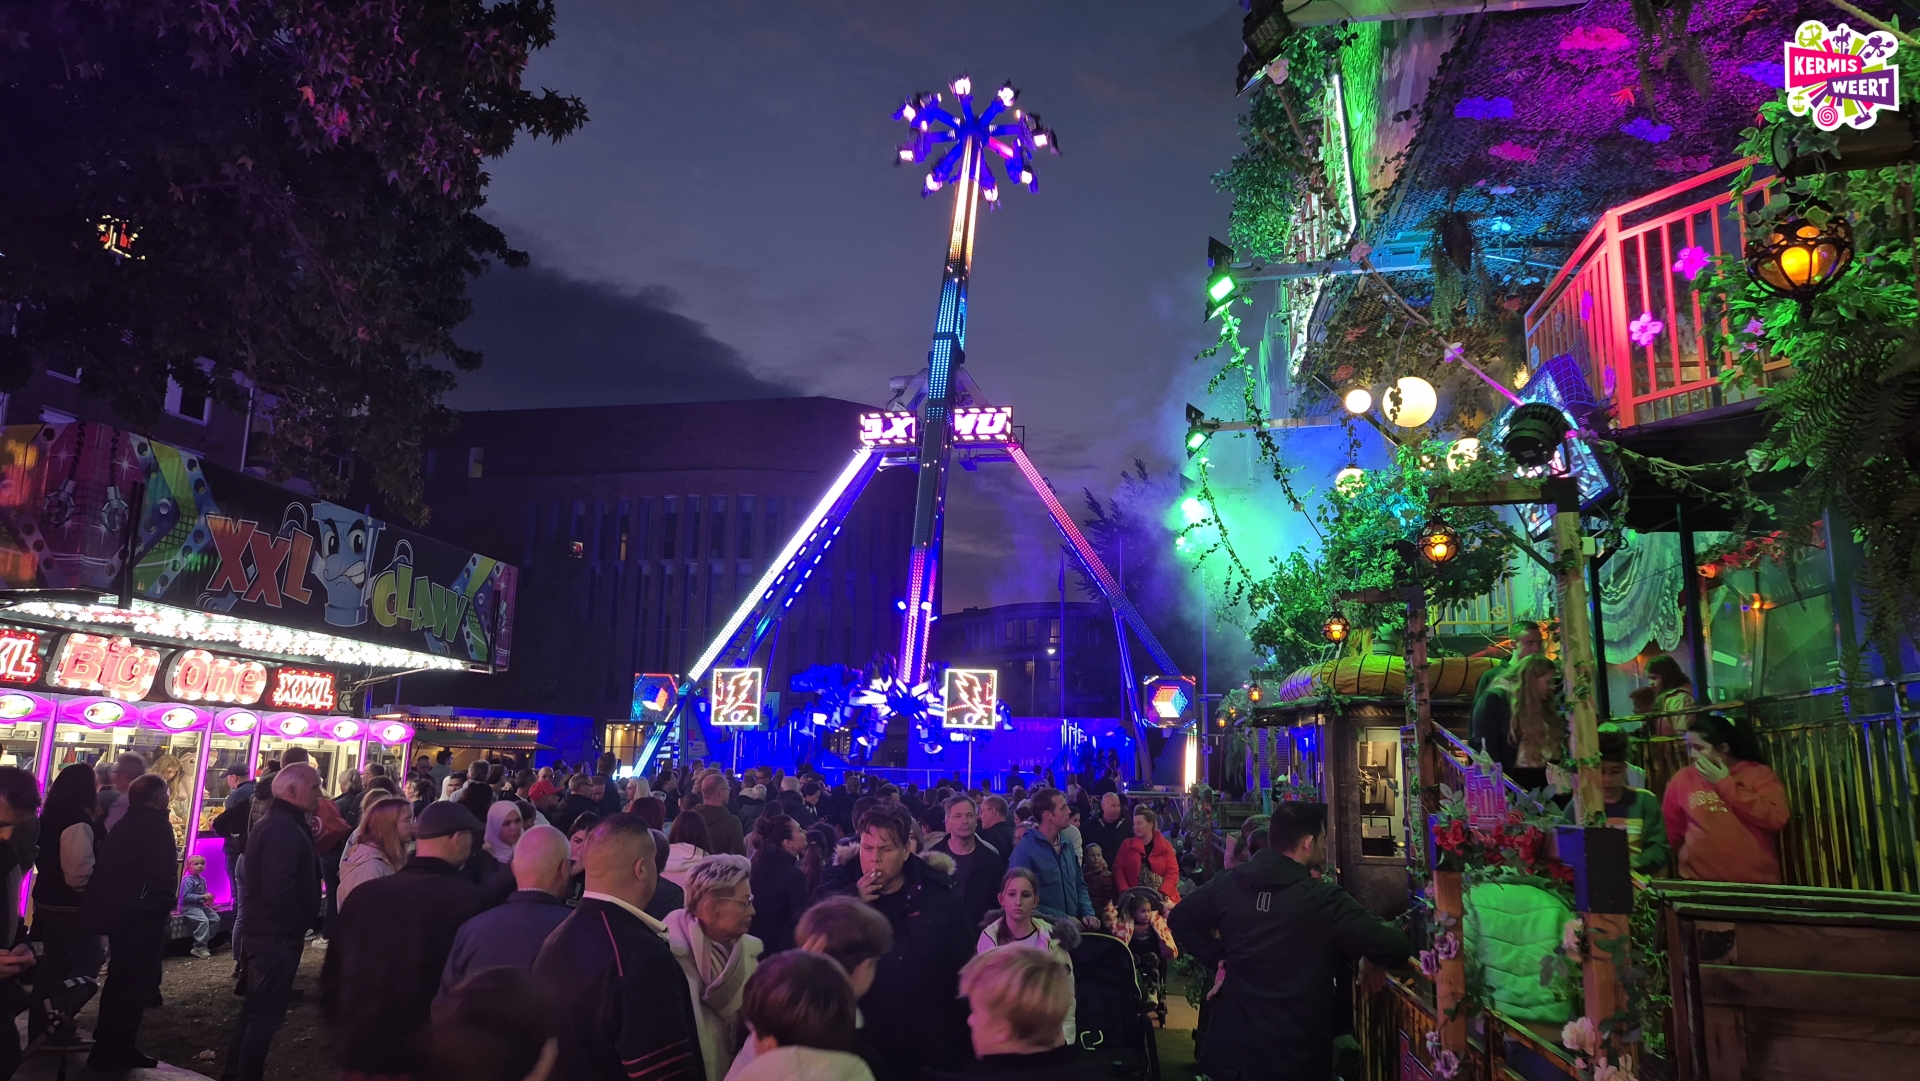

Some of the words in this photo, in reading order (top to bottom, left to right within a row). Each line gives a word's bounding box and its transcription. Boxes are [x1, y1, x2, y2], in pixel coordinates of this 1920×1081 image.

[205, 513, 314, 608] XXL
[371, 563, 469, 642] CLAW
[60, 639, 156, 695] Big
[177, 656, 263, 699] One
